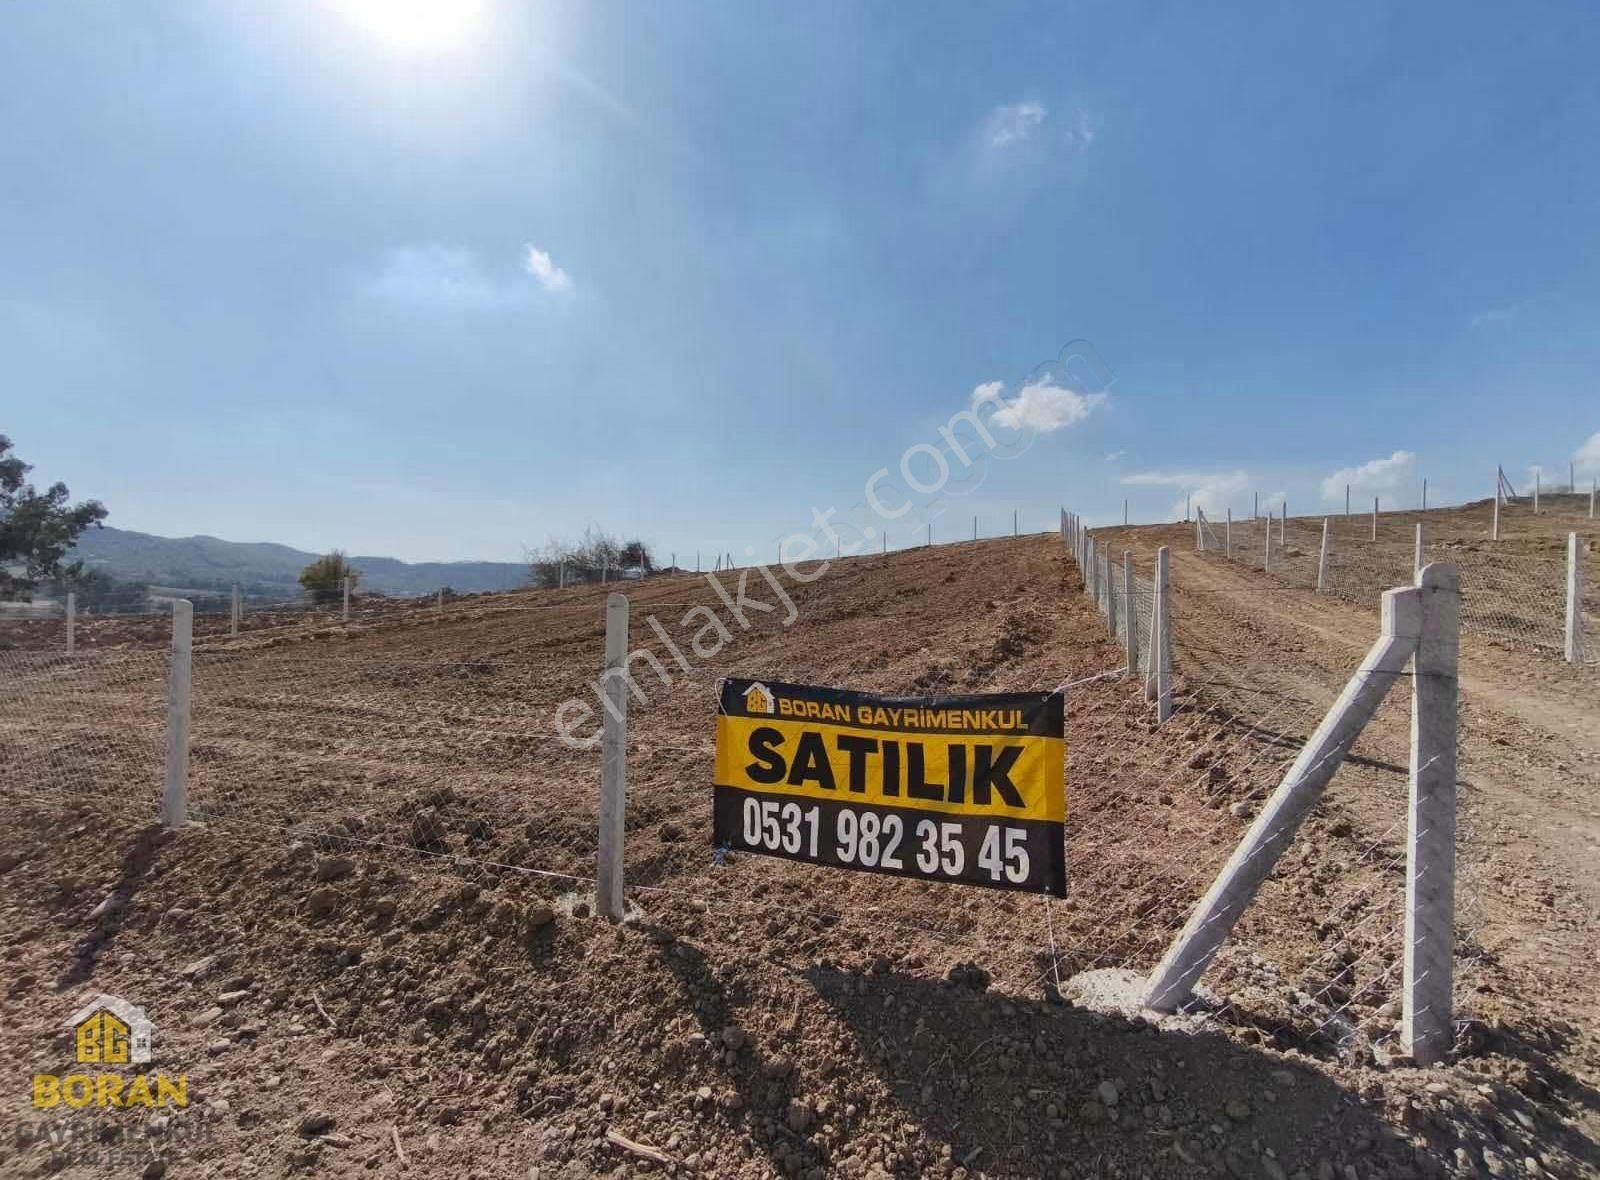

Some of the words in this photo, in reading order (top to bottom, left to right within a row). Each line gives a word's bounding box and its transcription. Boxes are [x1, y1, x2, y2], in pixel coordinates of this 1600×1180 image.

[779, 698, 851, 721] BORAN
[857, 705, 1029, 730] GAYRİMENKUL
[746, 727, 1027, 808] SATILIK
[743, 797, 820, 857] 0531
[836, 809, 904, 869] 982
[915, 819, 965, 876] 35
[978, 826, 1030, 883] 45
